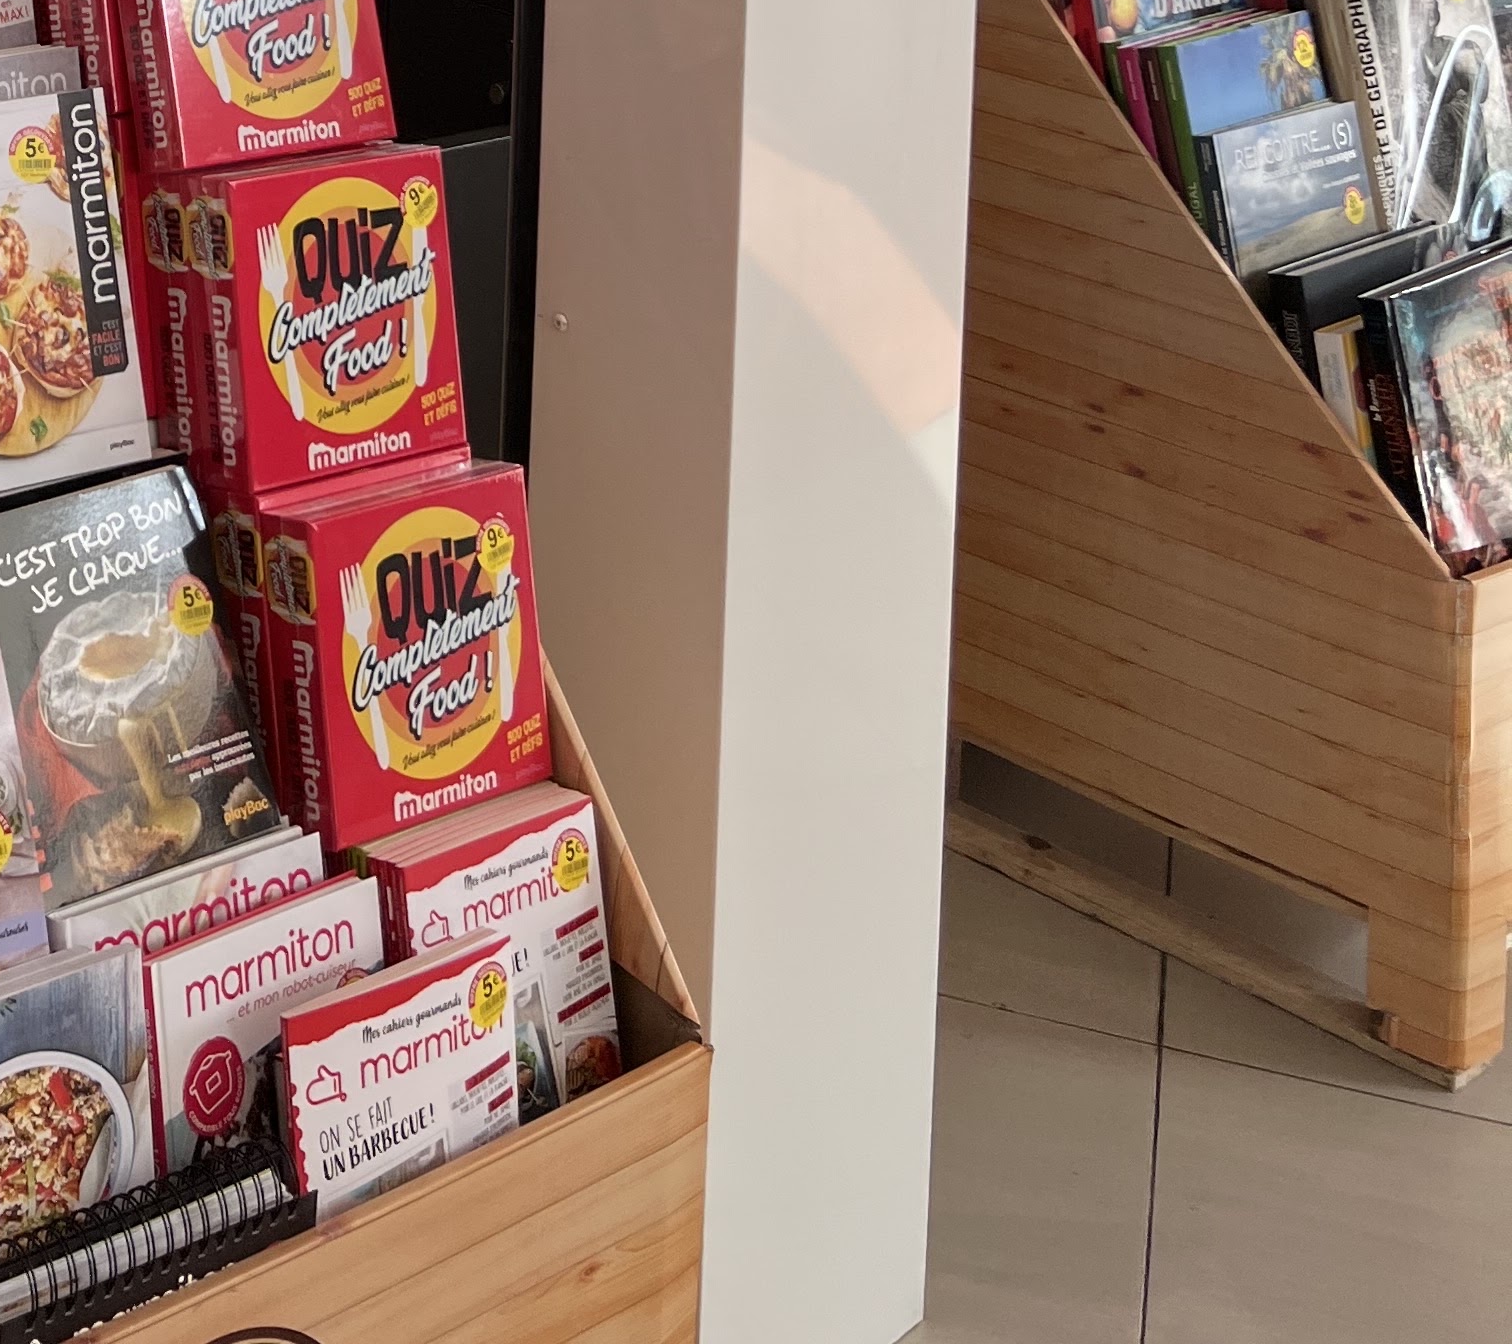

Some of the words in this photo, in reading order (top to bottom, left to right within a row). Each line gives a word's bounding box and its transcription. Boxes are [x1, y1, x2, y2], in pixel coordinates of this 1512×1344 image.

[248, 13, 318, 81] Food
[237, 118, 342, 152] marmiton
[1372, 105, 1387, 131] DE
[68, 102, 118, 305] marmiton
[92, 329, 121, 346] FACILE
[100, 318, 120, 332] C'EST
[211, 295, 238, 468] marmiton
[323, 318, 394, 397] Food
[307, 430, 412, 472] marmiton
[60, 511, 125, 559] TROP
[127, 487, 184, 532] BON
[30, 576, 64, 614] JE
[408, 654, 480, 741] Food
[292, 640, 323, 822] marmiton
[223, 797, 270, 826] playBac
[393, 769, 498, 823] marmiton
[185, 919, 355, 1018] marmiton
[237, 1003, 251, 1019] et
[252, 990, 280, 1012] mon
[361, 1022, 382, 1044] Mes
[383, 1011, 414, 1037] cahiers
[416, 993, 463, 1030] gourmands
[319, 1127, 342, 1154] ON
[346, 1114, 365, 1142] SE
[367, 1095, 394, 1135] FAIT
[321, 1154, 346, 1182] UN
